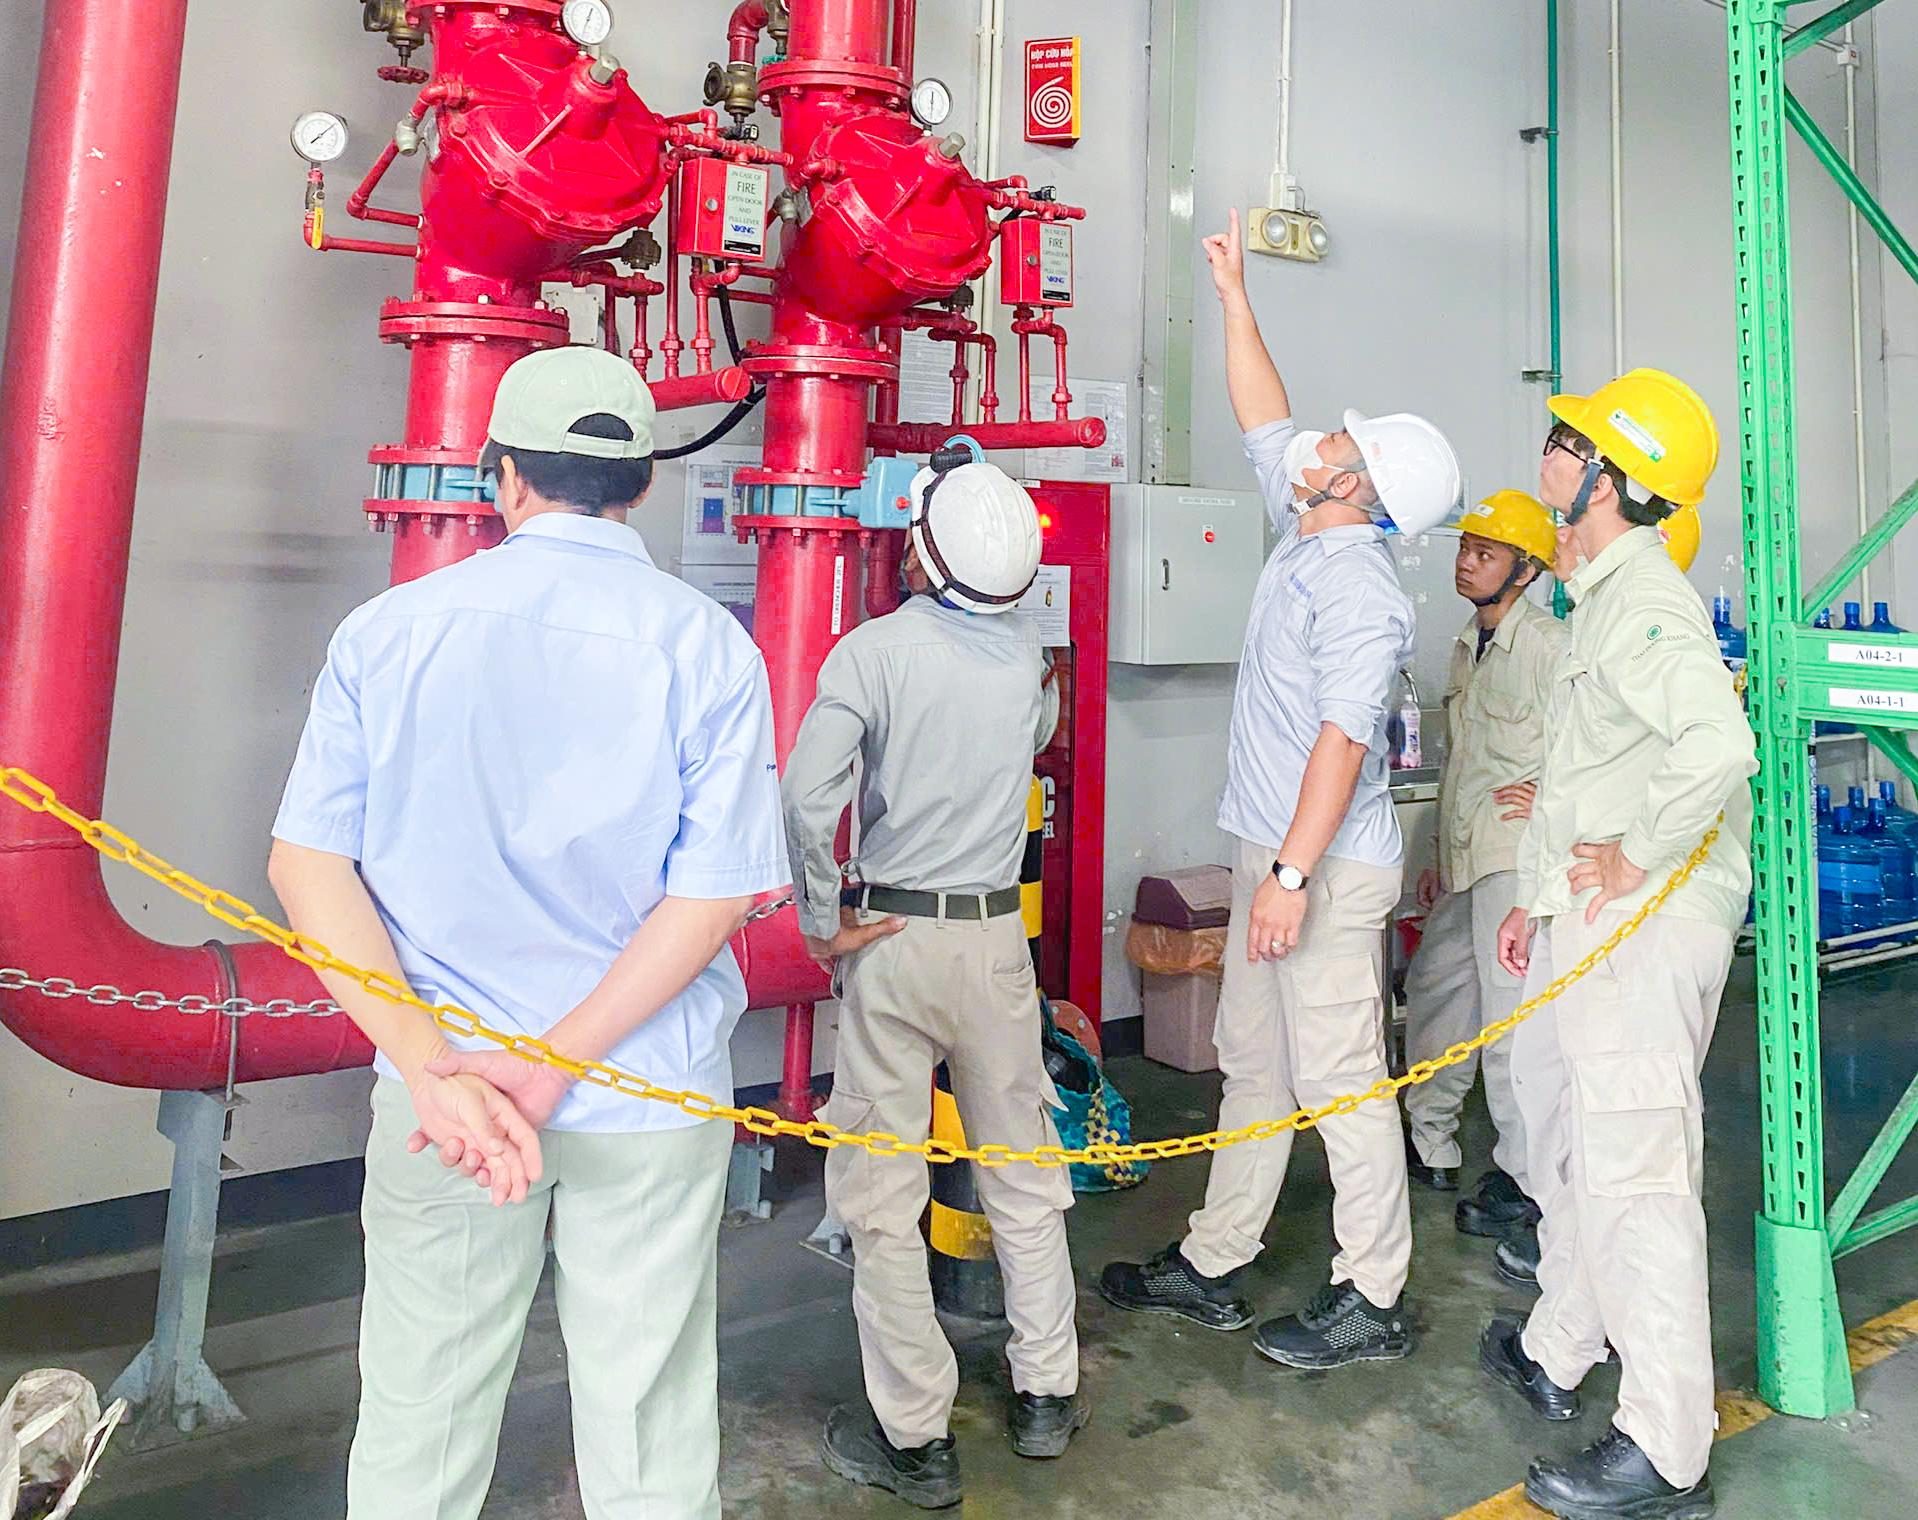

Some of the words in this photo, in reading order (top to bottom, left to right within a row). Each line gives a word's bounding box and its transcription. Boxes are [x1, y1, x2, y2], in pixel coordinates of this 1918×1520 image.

[737, 181, 756, 195] FIRE
[731, 224, 755, 234] VIKING
[1049, 237, 1063, 248] FIRE
[1856, 650, 1902, 663] A04-2-1
[1857, 695, 1904, 707] A04-1-1
